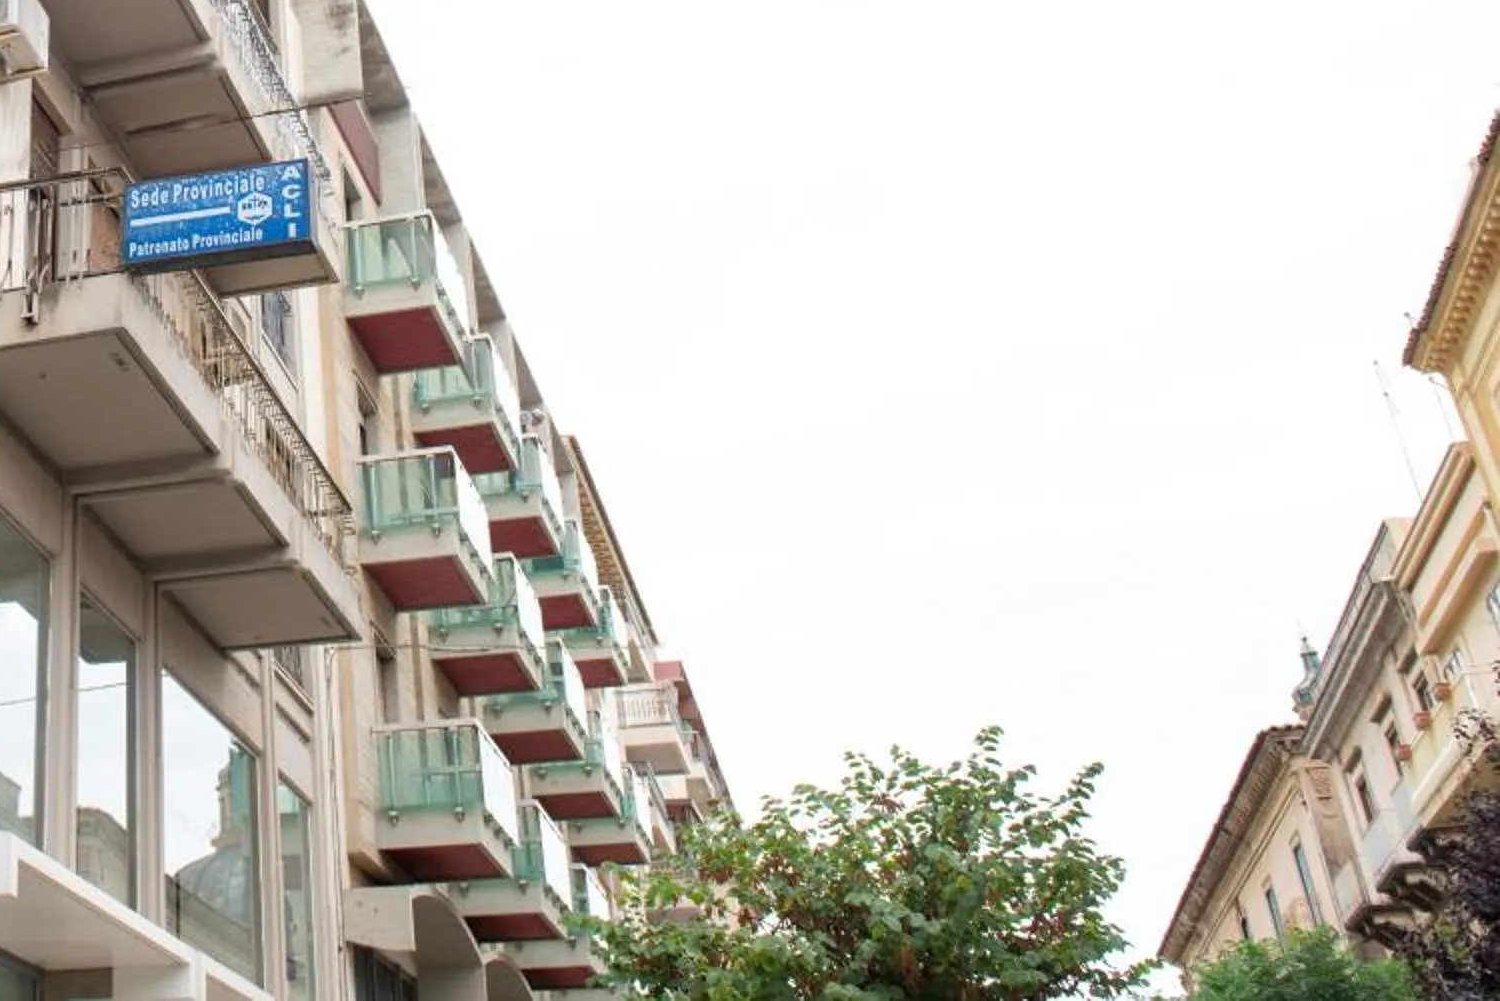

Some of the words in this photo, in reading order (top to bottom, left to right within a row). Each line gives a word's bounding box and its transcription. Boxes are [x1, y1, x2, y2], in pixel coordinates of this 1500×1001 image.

[130, 187, 169, 209] Sede
[173, 173, 266, 203] Provinciale
[282, 165, 301, 238] ACLI
[129, 238, 189, 258] Patronato
[192, 228, 263, 249] Provinciale
